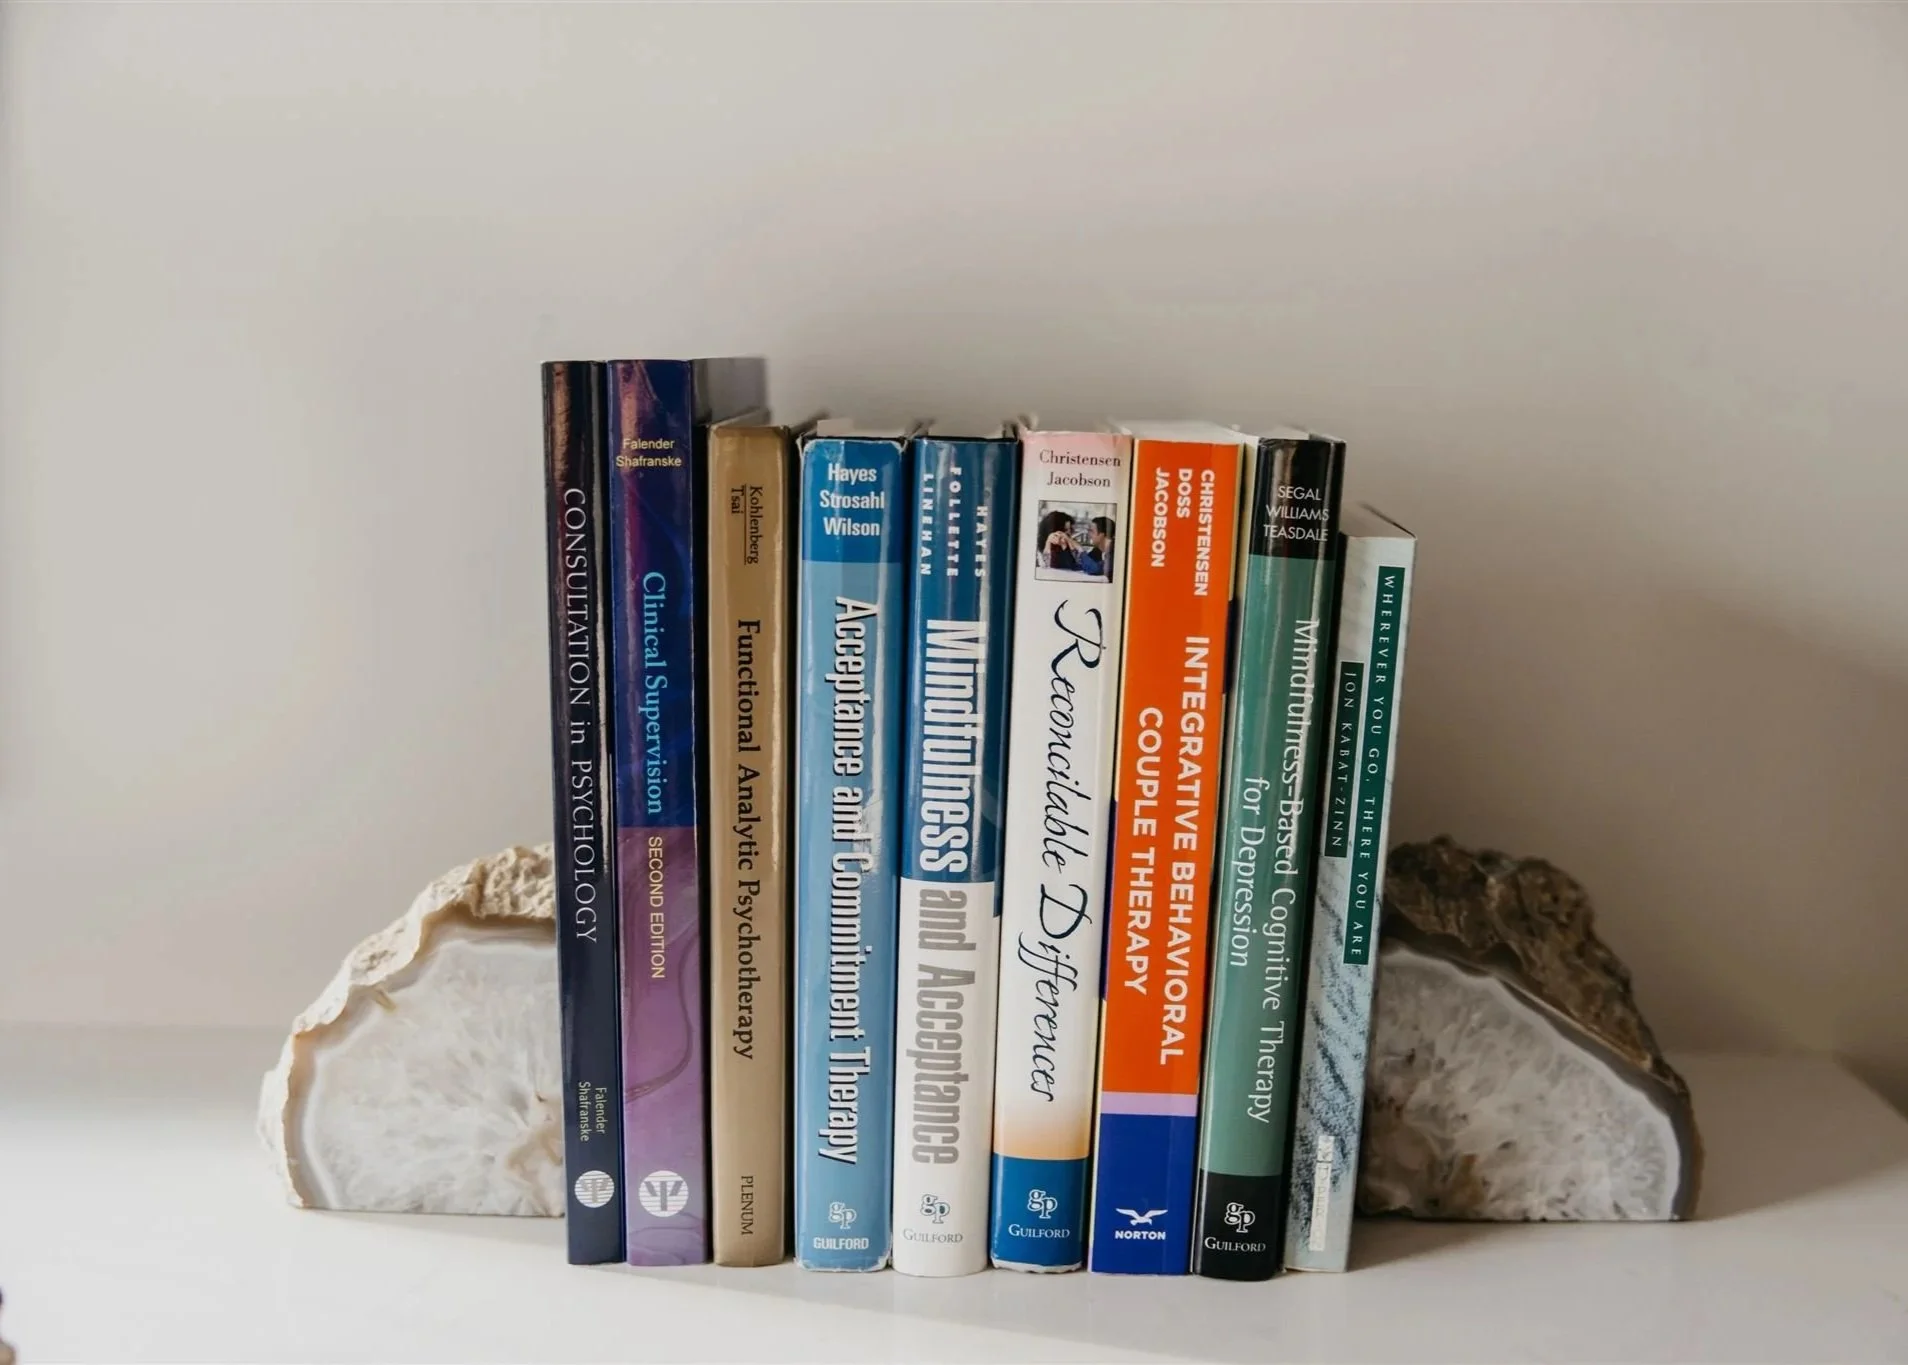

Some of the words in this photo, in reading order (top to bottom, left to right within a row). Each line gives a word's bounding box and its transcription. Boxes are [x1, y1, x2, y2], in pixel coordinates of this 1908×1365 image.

[615, 455, 683, 468] Shafranske
[623, 438, 675, 450] Falender
[828, 464, 877, 485] Hayes
[1039, 450, 1121, 468] Christensen
[731, 485, 745, 514] Tsai
[820, 491, 885, 509] Strosahl
[1047, 472, 1111, 488] Jacobson
[1176, 468, 1193, 519] DOSS
[1265, 505, 1330, 521] WILLIAMS
[1277, 486, 1322, 501] SEGAL
[747, 486, 764, 564] Kohlenberg
[823, 518, 880, 536] Wilson
[920, 473, 934, 575] LINEHAN
[947, 467, 962, 576] FOLLETTE
[974, 506, 988, 577] HAYES
[1151, 467, 1170, 567] JACOBSON
[1194, 469, 1216, 597] CHRISTENSEN
[1263, 524, 1329, 541] TEASDALE
[564, 488, 590, 705] CONSULTATION
[642, 571, 667, 670] Clinical
[1376, 575, 1395, 684] WHEREVER
[737, 619, 761, 752] Functional
[826, 596, 878, 777] Acceptance
[1371, 697, 1384, 735] YOU
[571, 721, 591, 744] in
[637, 675, 668, 815] Supervision
[920, 619, 986, 873] Mindfulness
[1042, 600, 1107, 874] Reconcilable
[1173, 636, 1210, 850] INTEGRATIVE
[1274, 619, 1320, 875] Mindfulness-Based
[1133, 707, 1163, 837] COUPLE
[1243, 777, 1270, 816] for
[1332, 722, 1352, 847] KABAT-ZINN
[732, 765, 760, 870] Analytic
[832, 786, 874, 841] and
[1360, 797, 1375, 858] THERE
[571, 760, 597, 943] PSYCHOLOGY
[648, 836, 664, 907] SECOND
[918, 888, 976, 951] and
[1123, 847, 1155, 995] THERAPY
[1230, 826, 1266, 967] Depression
[1355, 872, 1369, 909] YOU
[650, 912, 665, 979] EDITION
[732, 880, 761, 1060] Psychotherapy
[831, 853, 873, 1040] Commitment
[1160, 861, 1195, 1065] BEHAVIORAL
[1263, 888, 1297, 1010] Cognitive
[1351, 921, 1363, 955] ARE
[1018, 884, 1092, 1102] Differences
[906, 964, 976, 1165] Acceptance
[1247, 1020, 1286, 1124] Therapy
[579, 1081, 592, 1142] Shafranske
[595, 1087, 608, 1134] Falender
[818, 1047, 871, 1164] Therapy
[741, 1175, 754, 1236] PLENUM
[903, 1228, 963, 1244] GUILFORD
[1008, 1223, 1070, 1239] GUILFORD
[1114, 1230, 1166, 1241] NORTON
[813, 1236, 869, 1250] GUILFORD
[1204, 1236, 1266, 1253] GUILFORD
